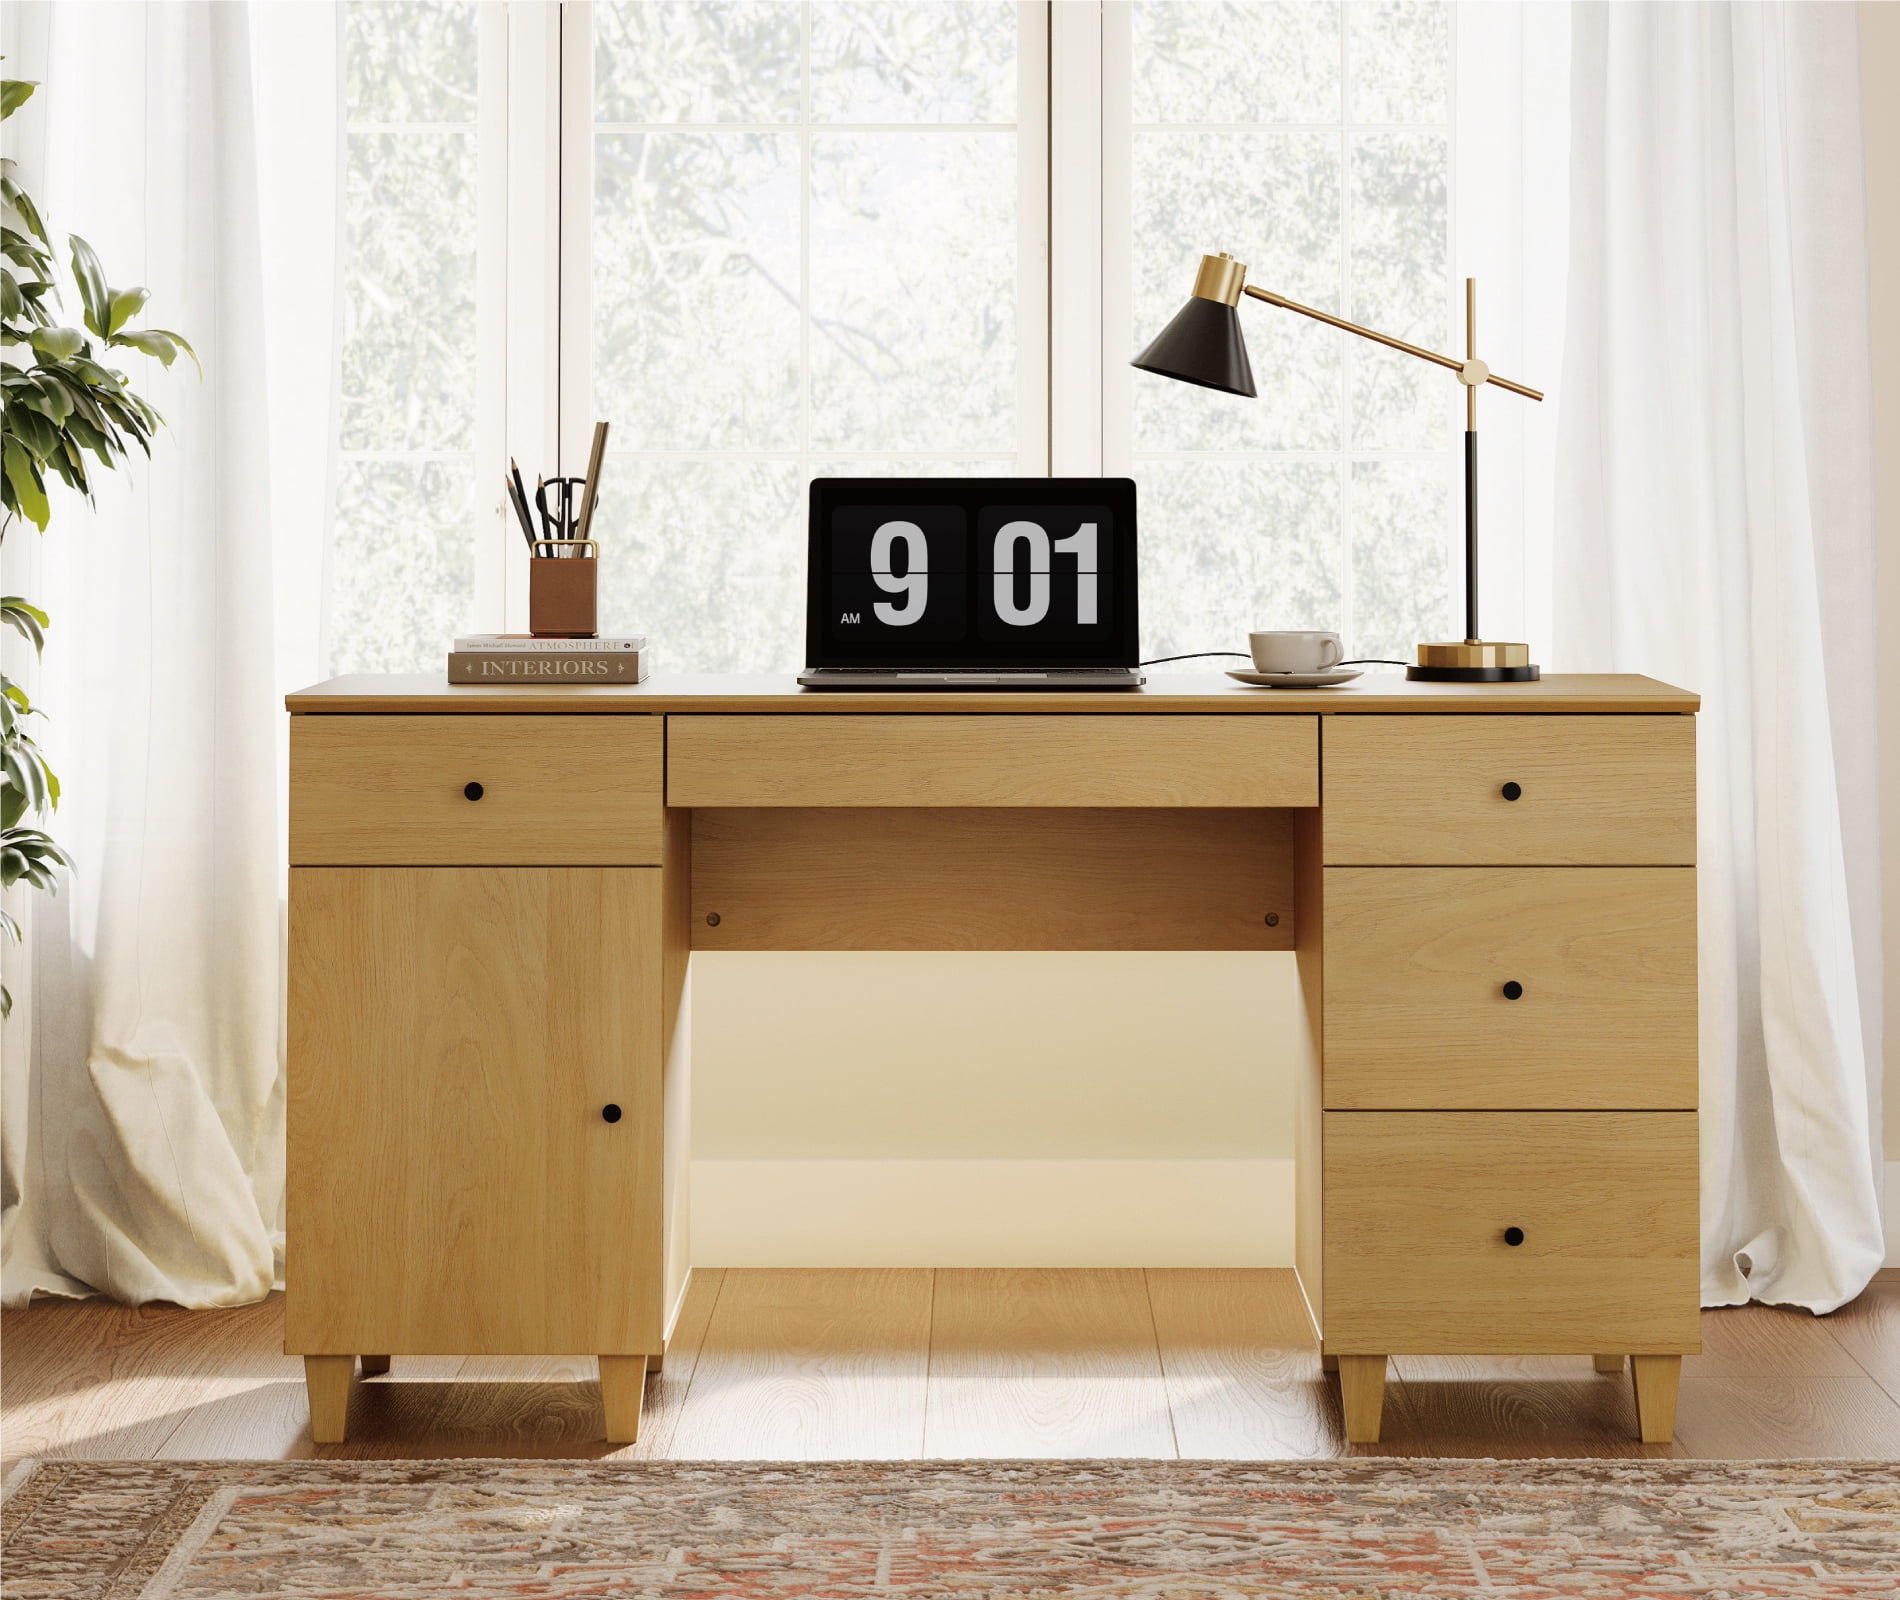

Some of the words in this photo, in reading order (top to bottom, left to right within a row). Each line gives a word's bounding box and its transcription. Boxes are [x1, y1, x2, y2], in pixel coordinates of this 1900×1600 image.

[870, 520, 928, 626] 9
[993, 520, 1097, 626] 01
[840, 612, 861, 625] AM
[528, 641, 619, 651] ATMOSPHERE
[480, 660, 608, 676] INTERIORS
